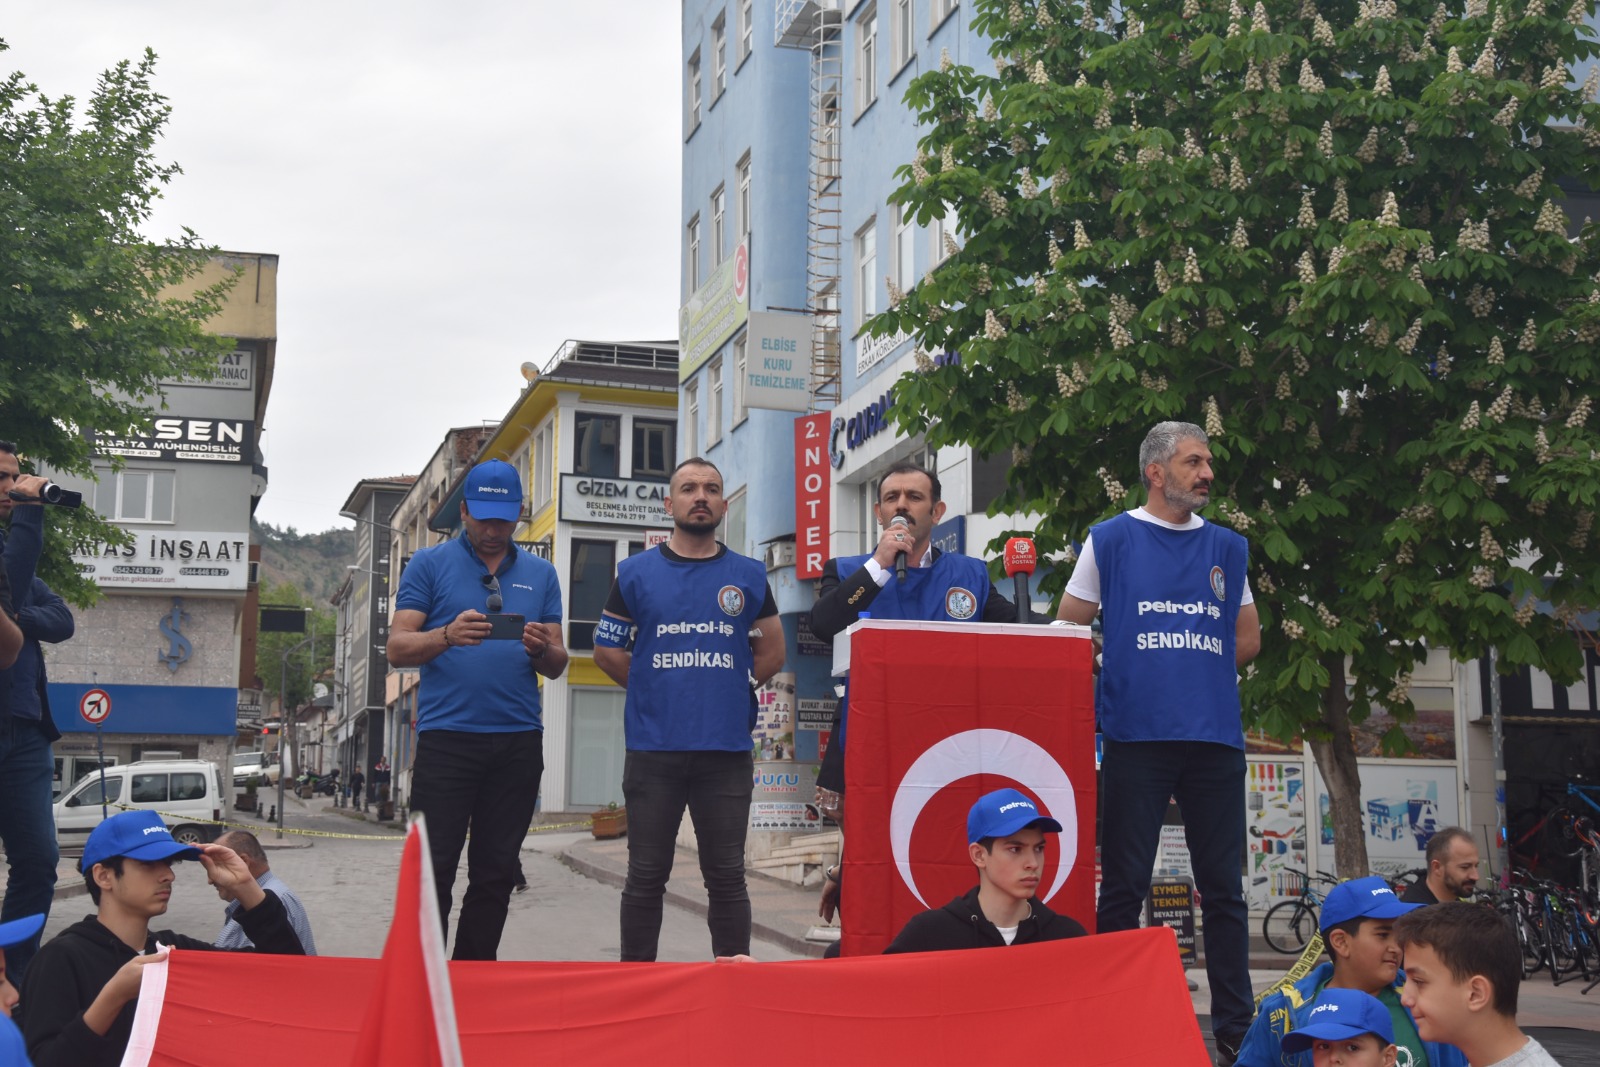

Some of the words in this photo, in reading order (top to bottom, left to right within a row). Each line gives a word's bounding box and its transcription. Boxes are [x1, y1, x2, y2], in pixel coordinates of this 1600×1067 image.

[762, 337, 796, 352] ELBİSE
[764, 358, 792, 371] KURU
[749, 373, 805, 390] TEMİZLEME
[806, 421, 820, 438] 2.
[153, 440, 241, 453] MÜHENDİSLİK
[576, 478, 628, 498] GİZEM
[636, 485, 665, 502] CAL
[586, 502, 620, 511] BESLENME
[628, 504, 646, 513] DİYET
[804, 447, 822, 573] NOTER
[151, 535, 244, 563] İNŞAAT
[649, 536, 668, 546] KENT
[520, 544, 545, 558] KAT
[1138, 600, 1220, 620] petrol-iş
[656, 621, 734, 637] petrol-iş
[1137, 630, 1222, 655] SENDİKASI
[652, 648, 734, 669] SENDİKASI
[760, 688, 776, 704] İF
[1152, 885, 1188, 895] EYMEN
[1152, 898, 1190, 908] TEKNİK
[1175, 910, 1190, 918] EŞYA
